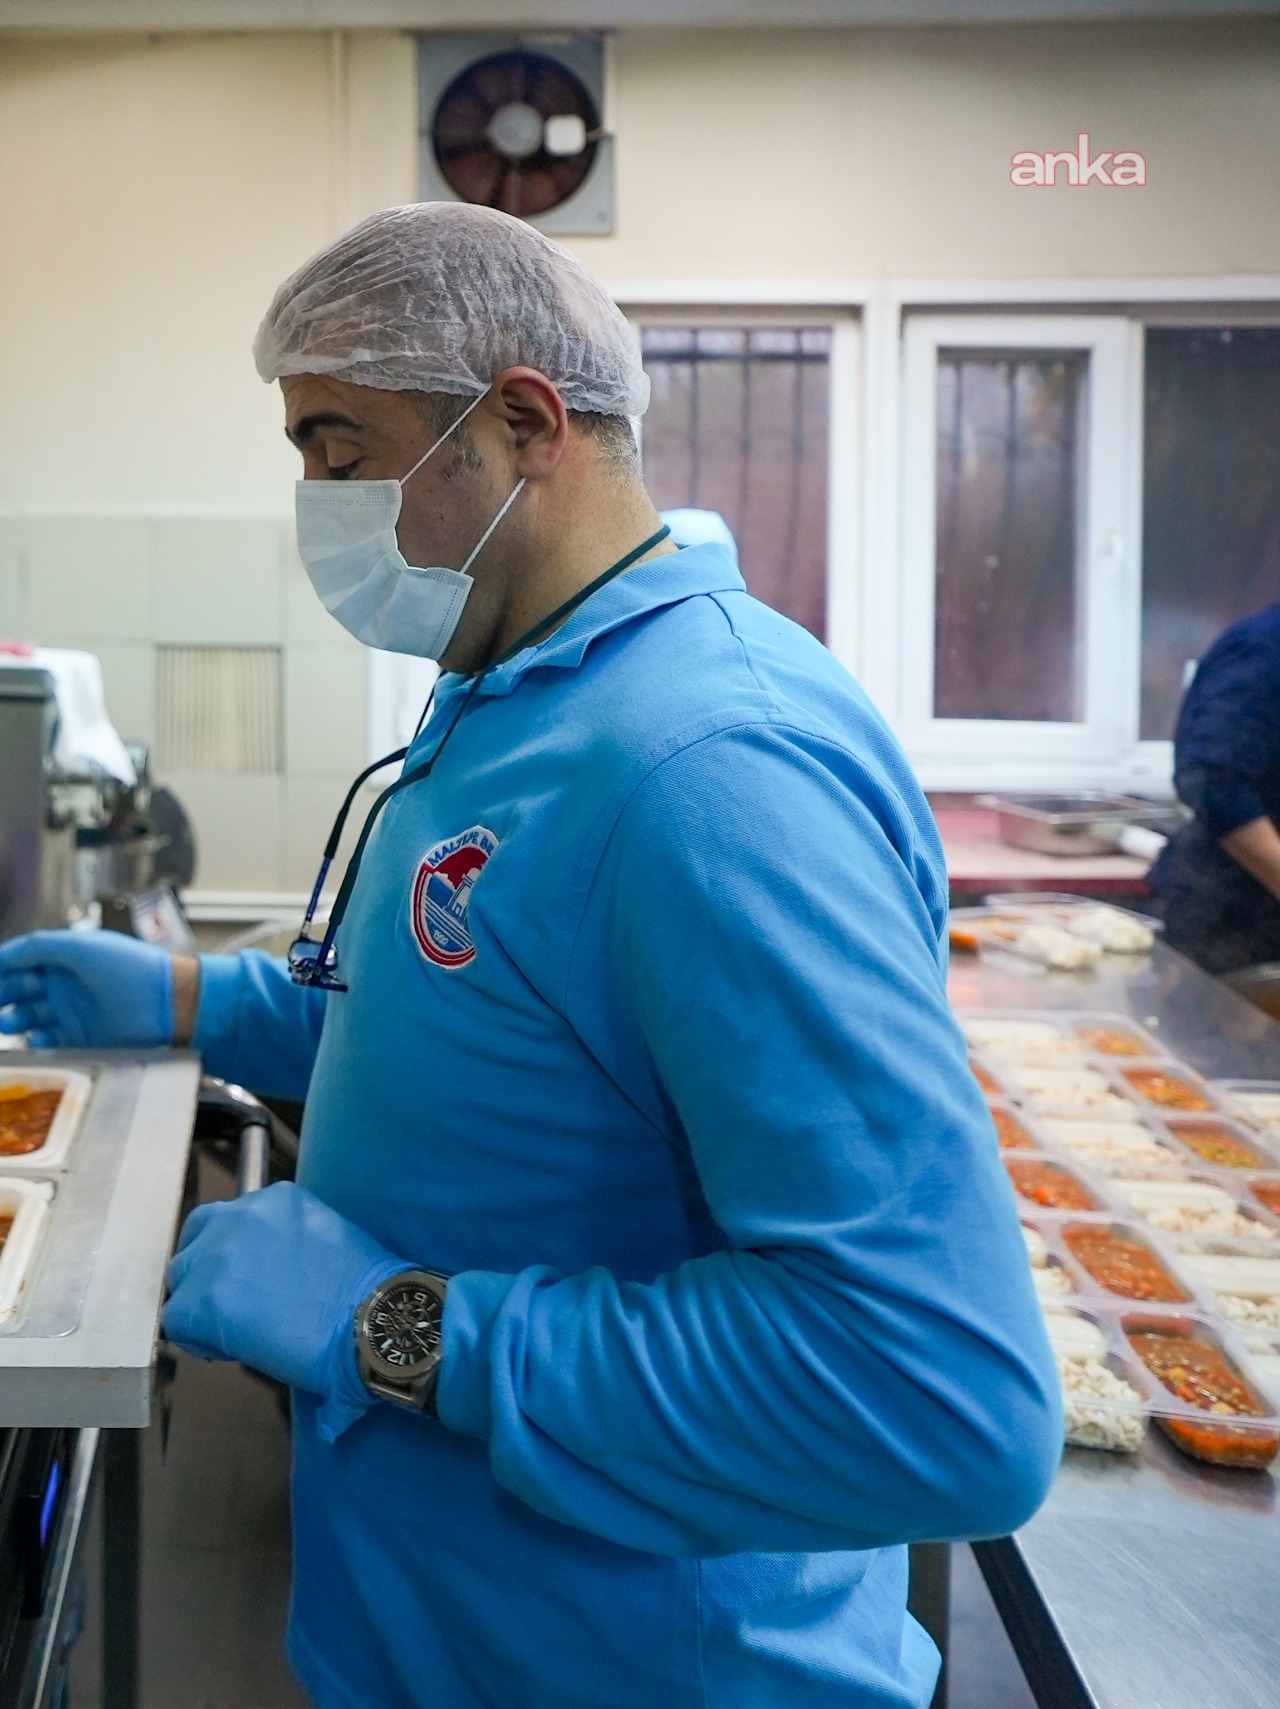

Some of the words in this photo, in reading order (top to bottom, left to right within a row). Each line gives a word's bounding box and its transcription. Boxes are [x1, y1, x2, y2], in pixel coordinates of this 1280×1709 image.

[428, 831, 479, 867] MALTEPE
[376, 1312, 388, 1325] 3
[386, 1349, 406, 1366] 12
